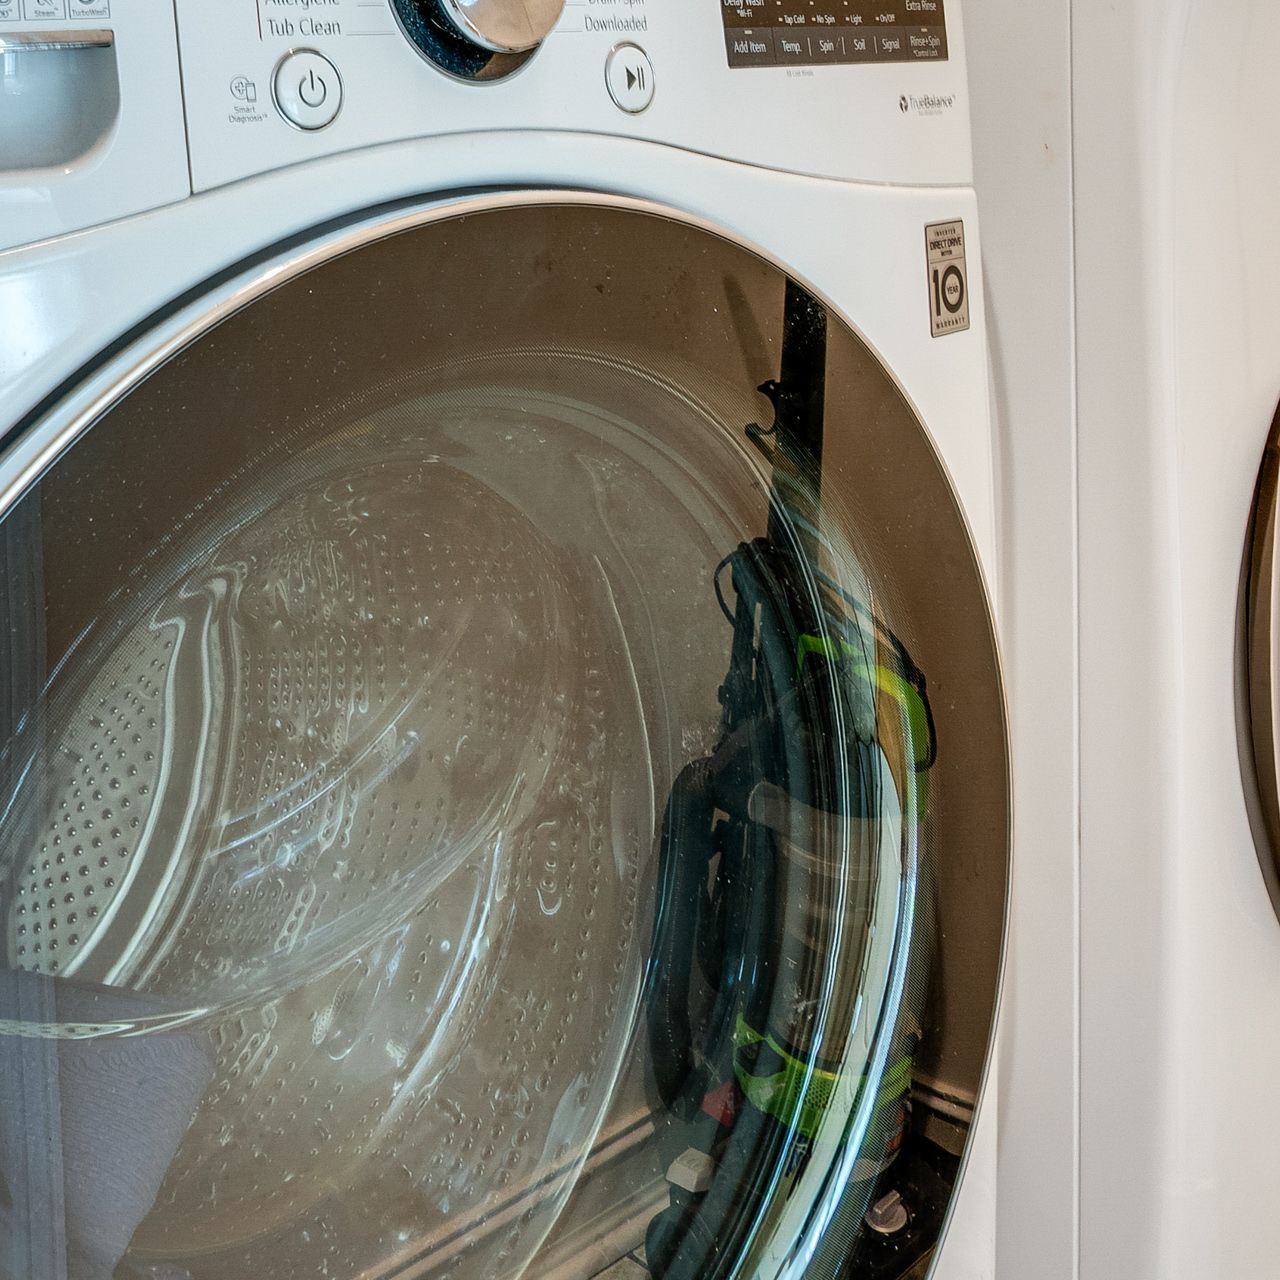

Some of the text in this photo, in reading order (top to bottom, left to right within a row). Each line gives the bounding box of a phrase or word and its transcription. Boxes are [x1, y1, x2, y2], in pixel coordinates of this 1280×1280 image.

[906, 0, 936, 11] Extra Rinse
[584, 16, 648, 32] Downloaded
[784, 15, 805, 25] Tap Cold
[816, 15, 835, 25] No Spin
[850, 15, 862, 25] Light
[268, 18, 341, 36] Tub Clean
[734, 41, 766, 53] Add Item
[782, 40, 802, 54] Temp.
[820, 40, 834, 54] Spin
[854, 39, 866, 50] Soil
[882, 38, 900, 52] Signal
[910, 36, 940, 48] Rinse+Spin
[234, 106, 256, 114] Smart
[930, 237, 962, 250] DIRECT DRIVE
[933, 265, 964, 316] 10
[947, 286, 959, 295] YEAR
[936, 317, 965, 329] WARRANTY
